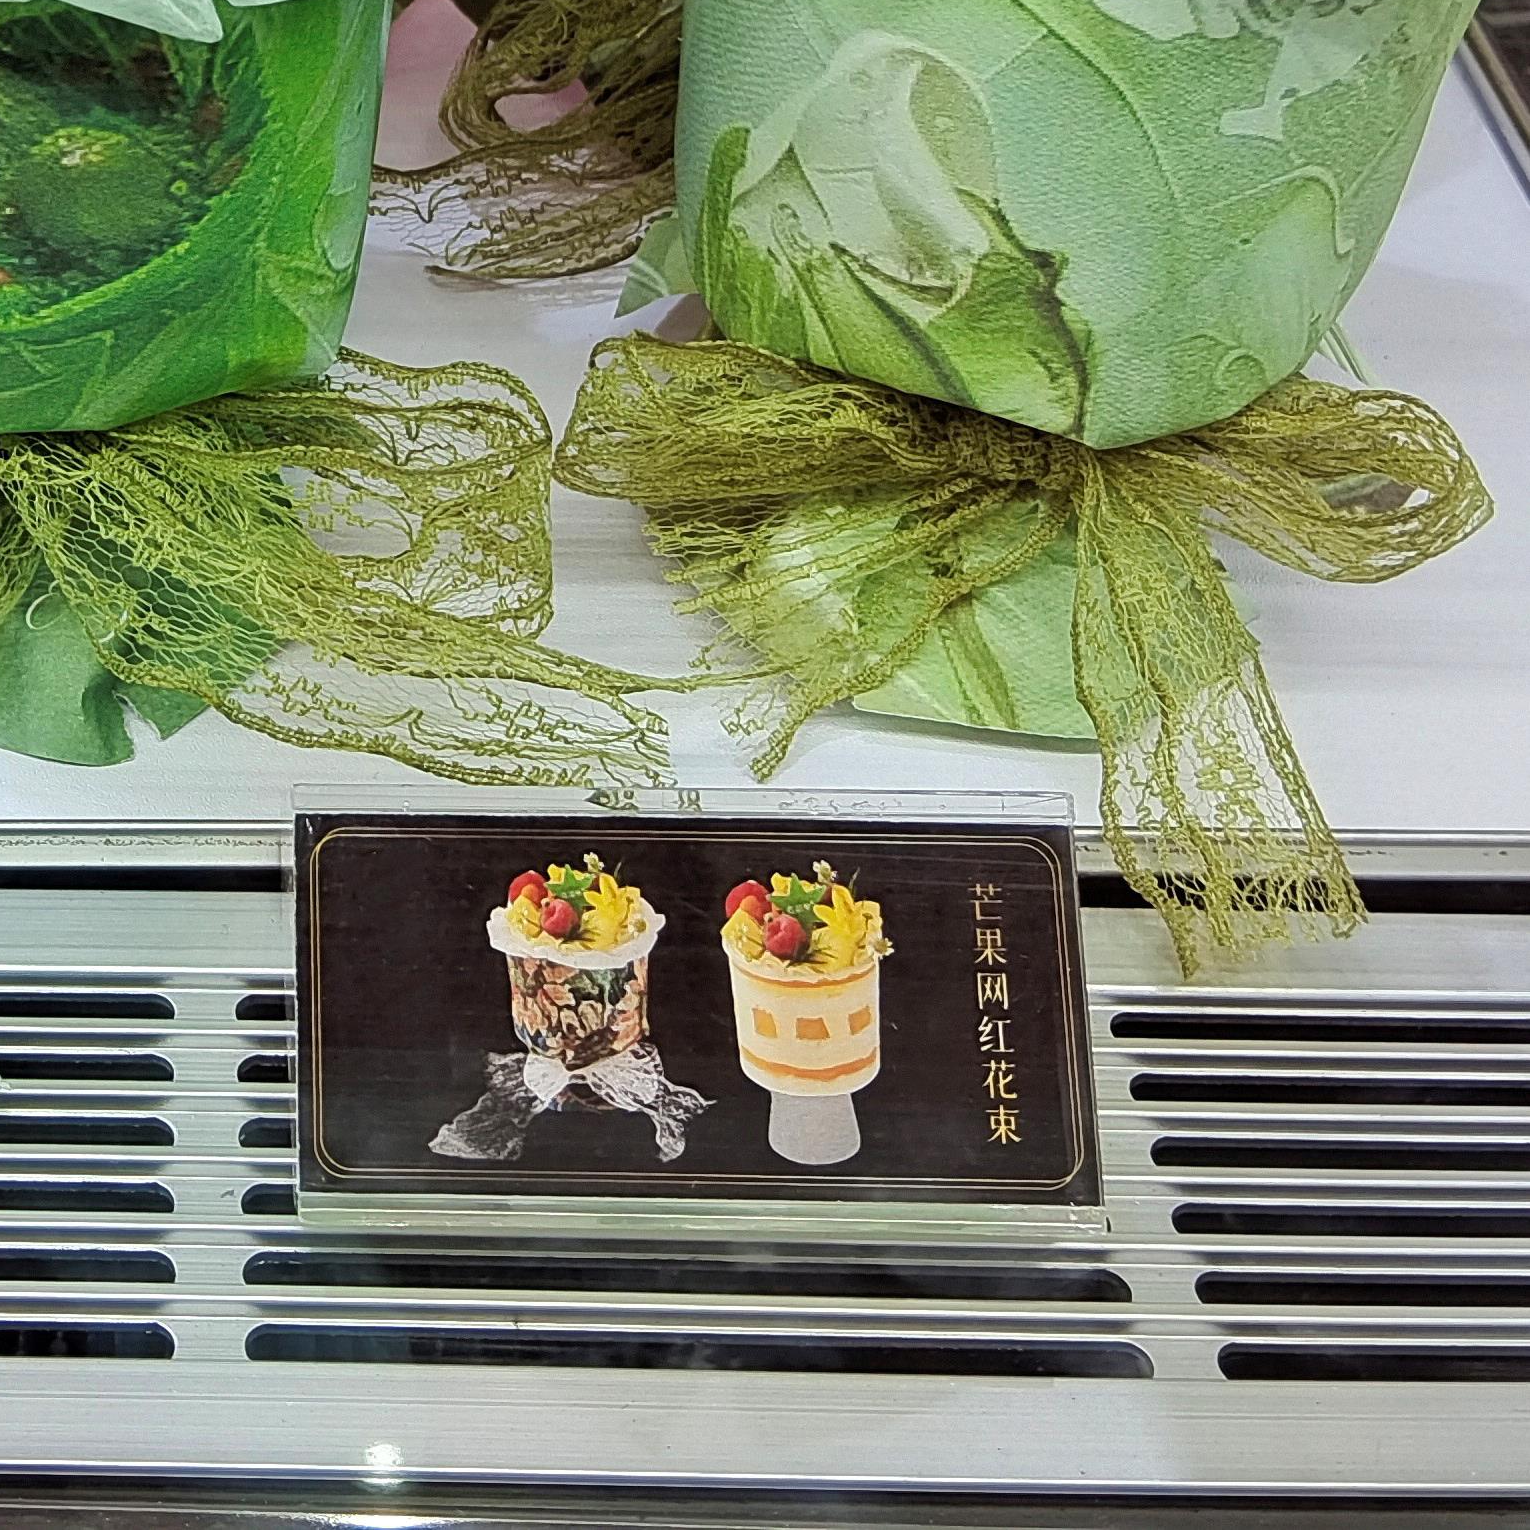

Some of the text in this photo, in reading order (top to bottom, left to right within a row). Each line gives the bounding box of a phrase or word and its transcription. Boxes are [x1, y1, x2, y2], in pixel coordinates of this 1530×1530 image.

[967, 882, 1023, 1146] 芒果网红花束
